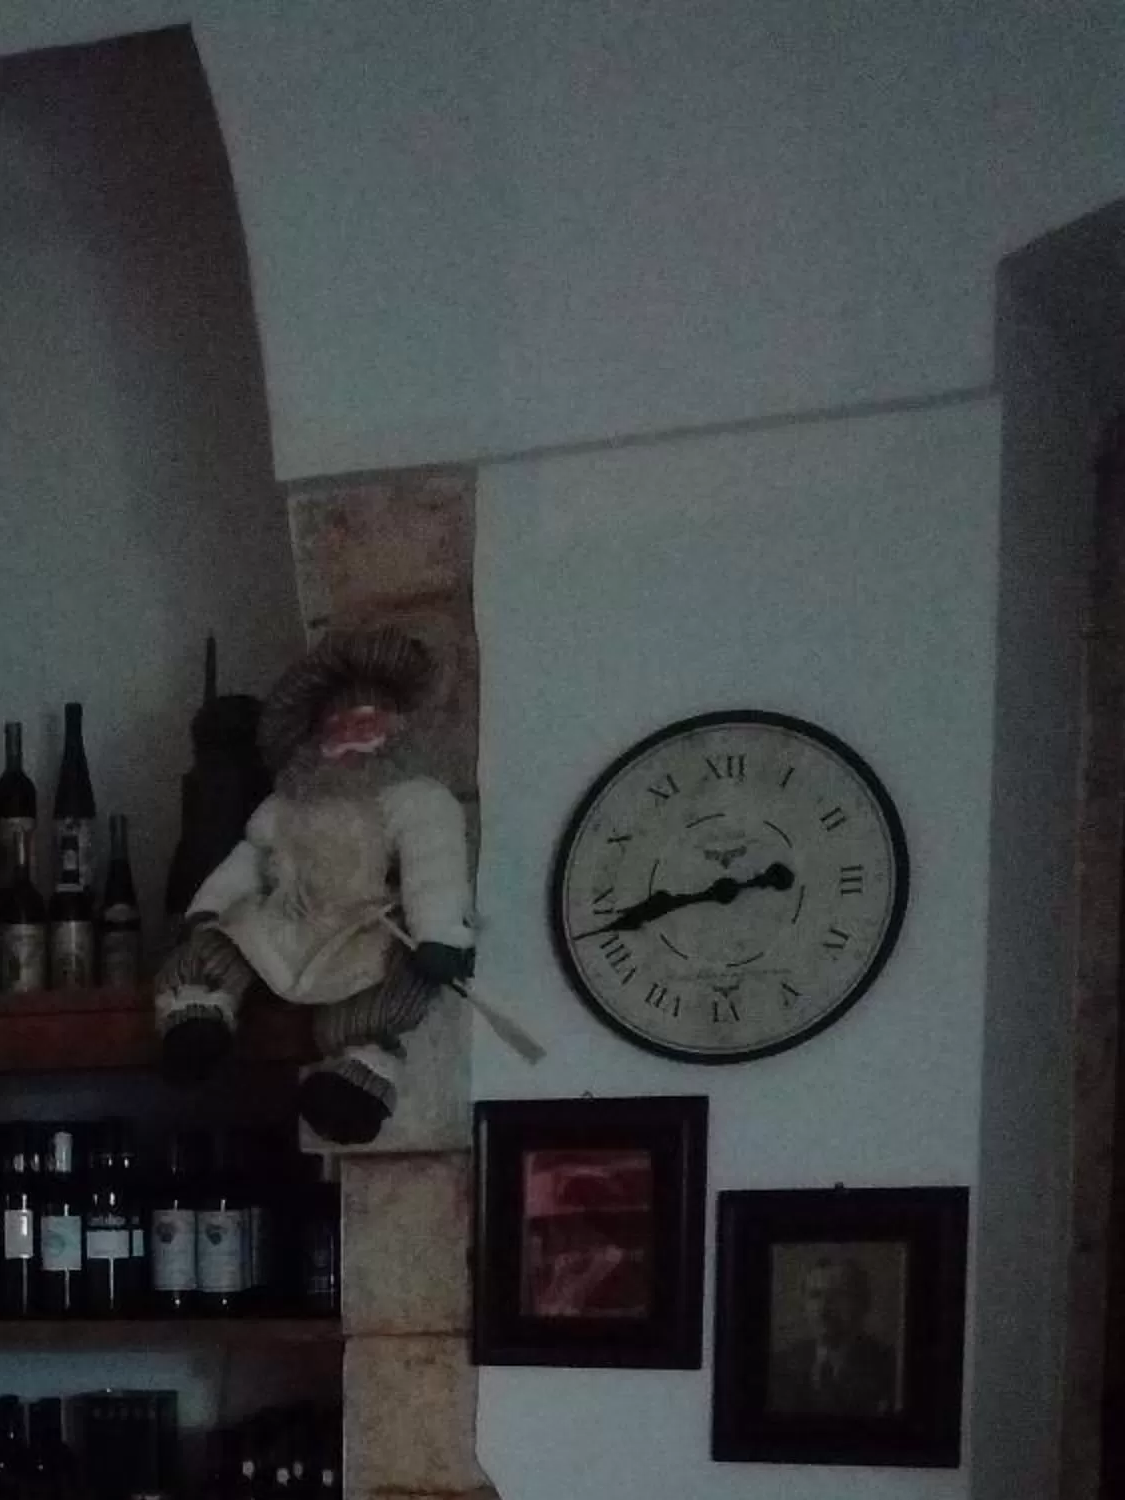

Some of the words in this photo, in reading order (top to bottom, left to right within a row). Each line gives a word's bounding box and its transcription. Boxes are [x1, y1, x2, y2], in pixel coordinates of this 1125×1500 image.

[704, 753, 747, 780] XII
[647, 773, 681, 806] XI
[820, 806, 848, 832] II
[839, 863, 865, 895] III
